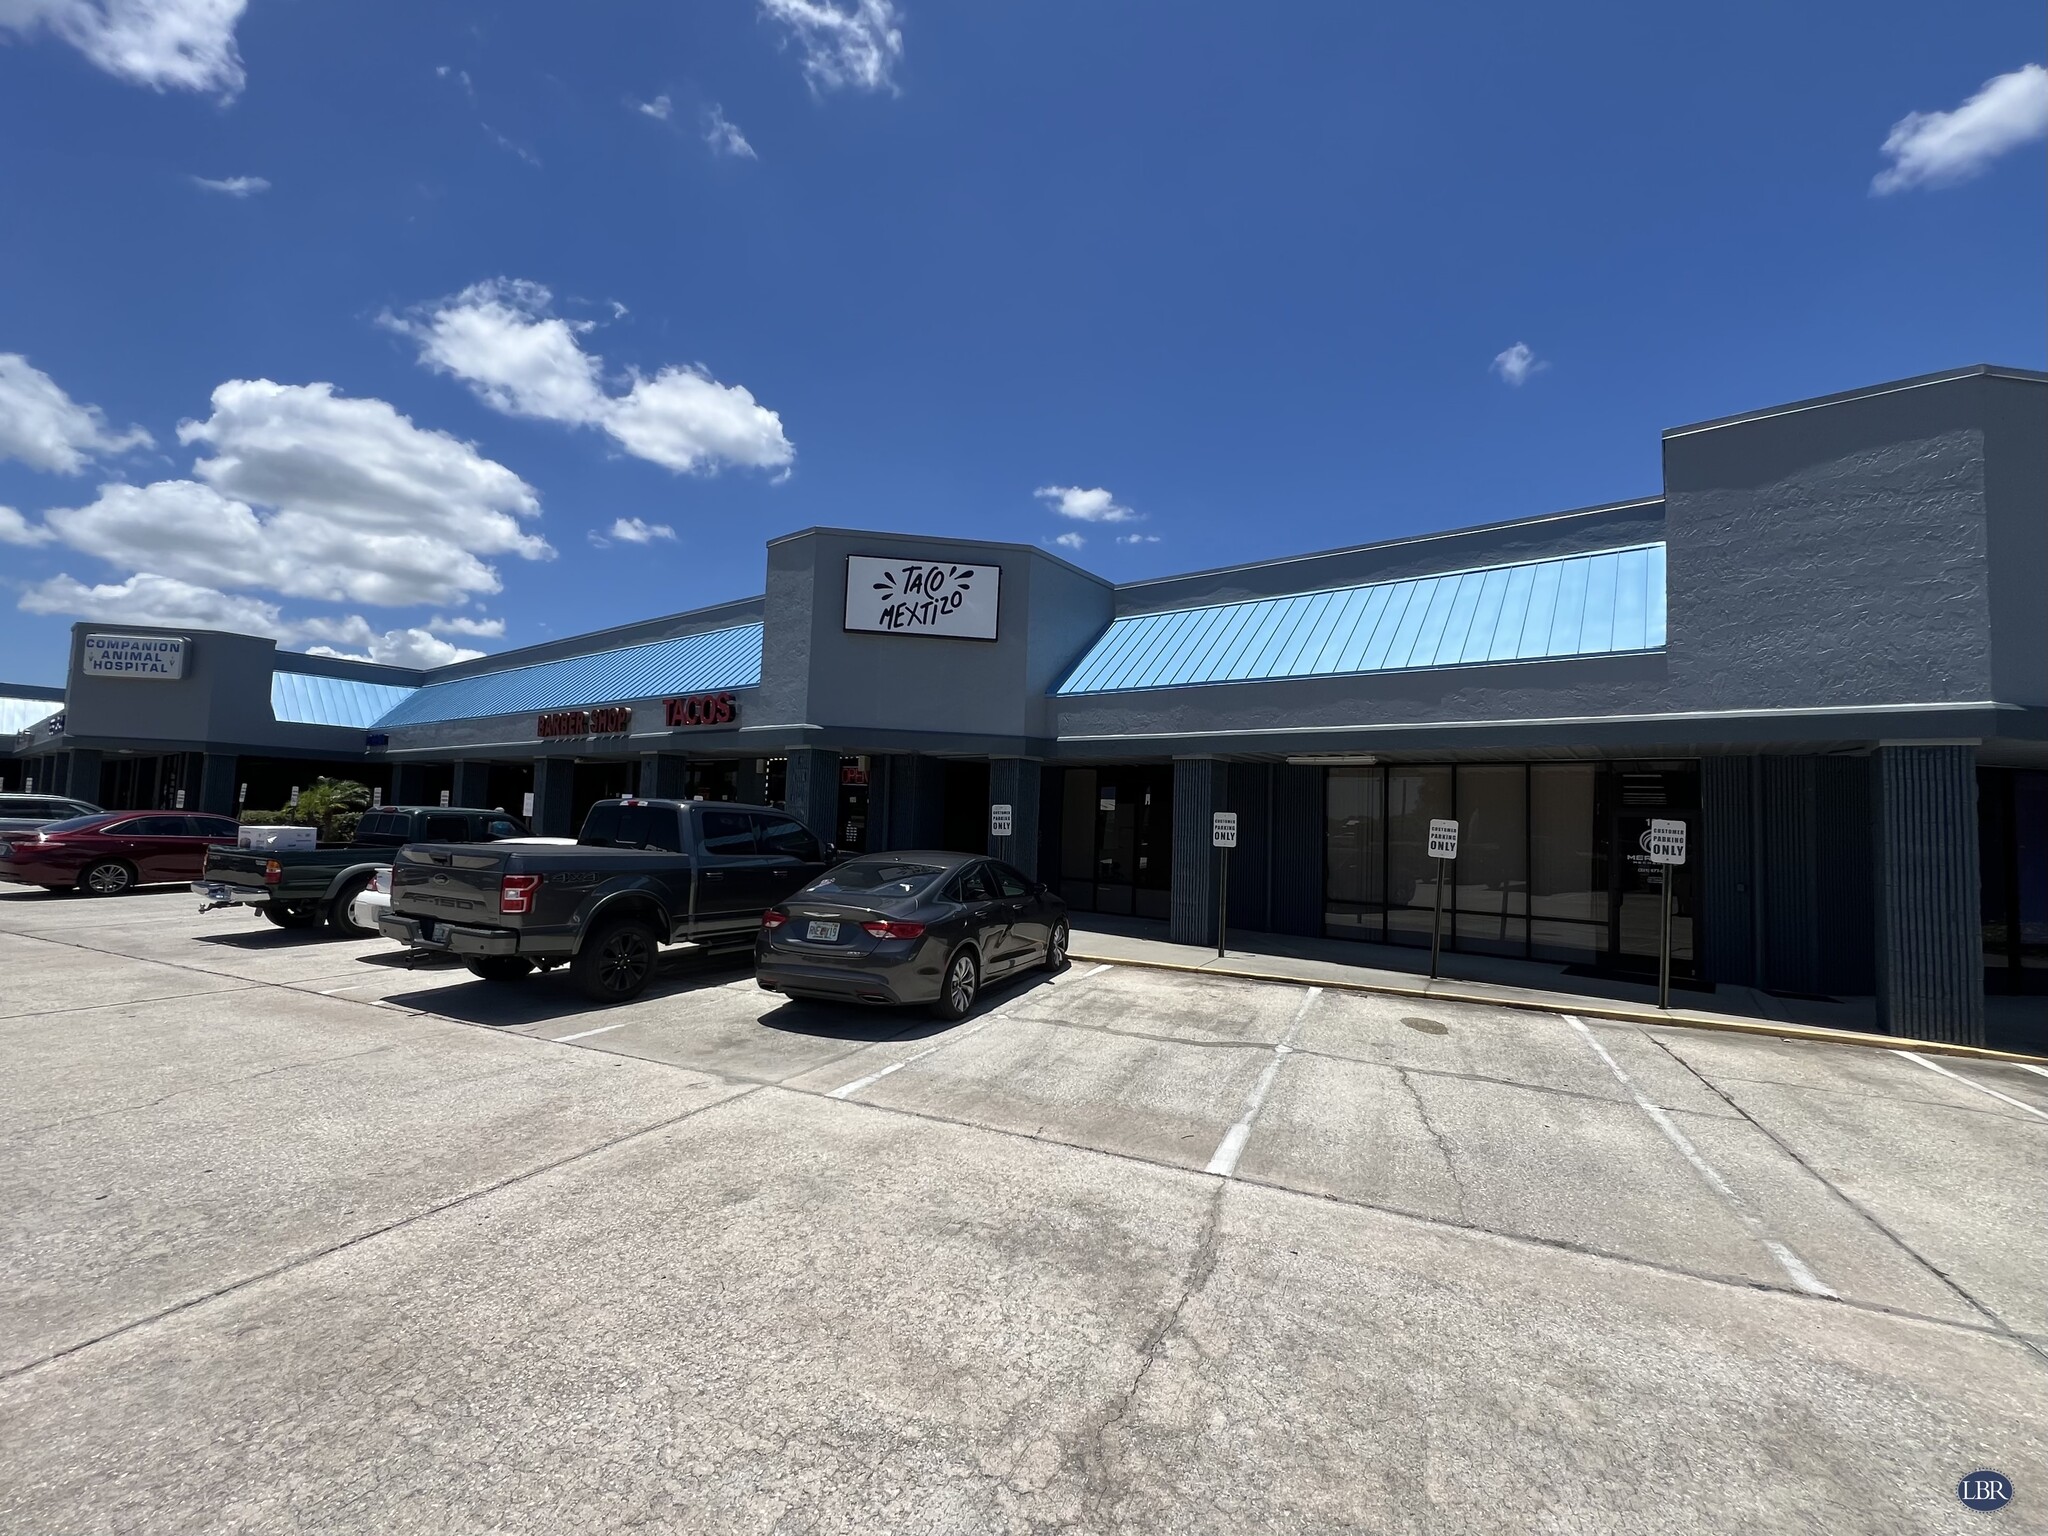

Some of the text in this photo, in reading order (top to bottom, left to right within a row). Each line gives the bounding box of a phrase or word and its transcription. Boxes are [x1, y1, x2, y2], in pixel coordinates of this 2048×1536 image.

[902, 566, 944, 600] TACO
[86, 638, 180, 653] COMPANION
[101, 650, 162, 662] ANIMAL
[93, 661, 168, 673] HOSPITAL
[663, 692, 736, 727] TACOS
[537, 707, 631, 737] BARBER SHOP
[993, 822, 1011, 830] ONLY
[1214, 831, 1235, 841] ONLY
[1430, 833, 1456, 841] PARKING
[1653, 836, 1684, 844] PARKING
[1430, 840, 1456, 852] ONLY
[1653, 844, 1684, 857] ONLY
[412, 895, 474, 910] F-150
